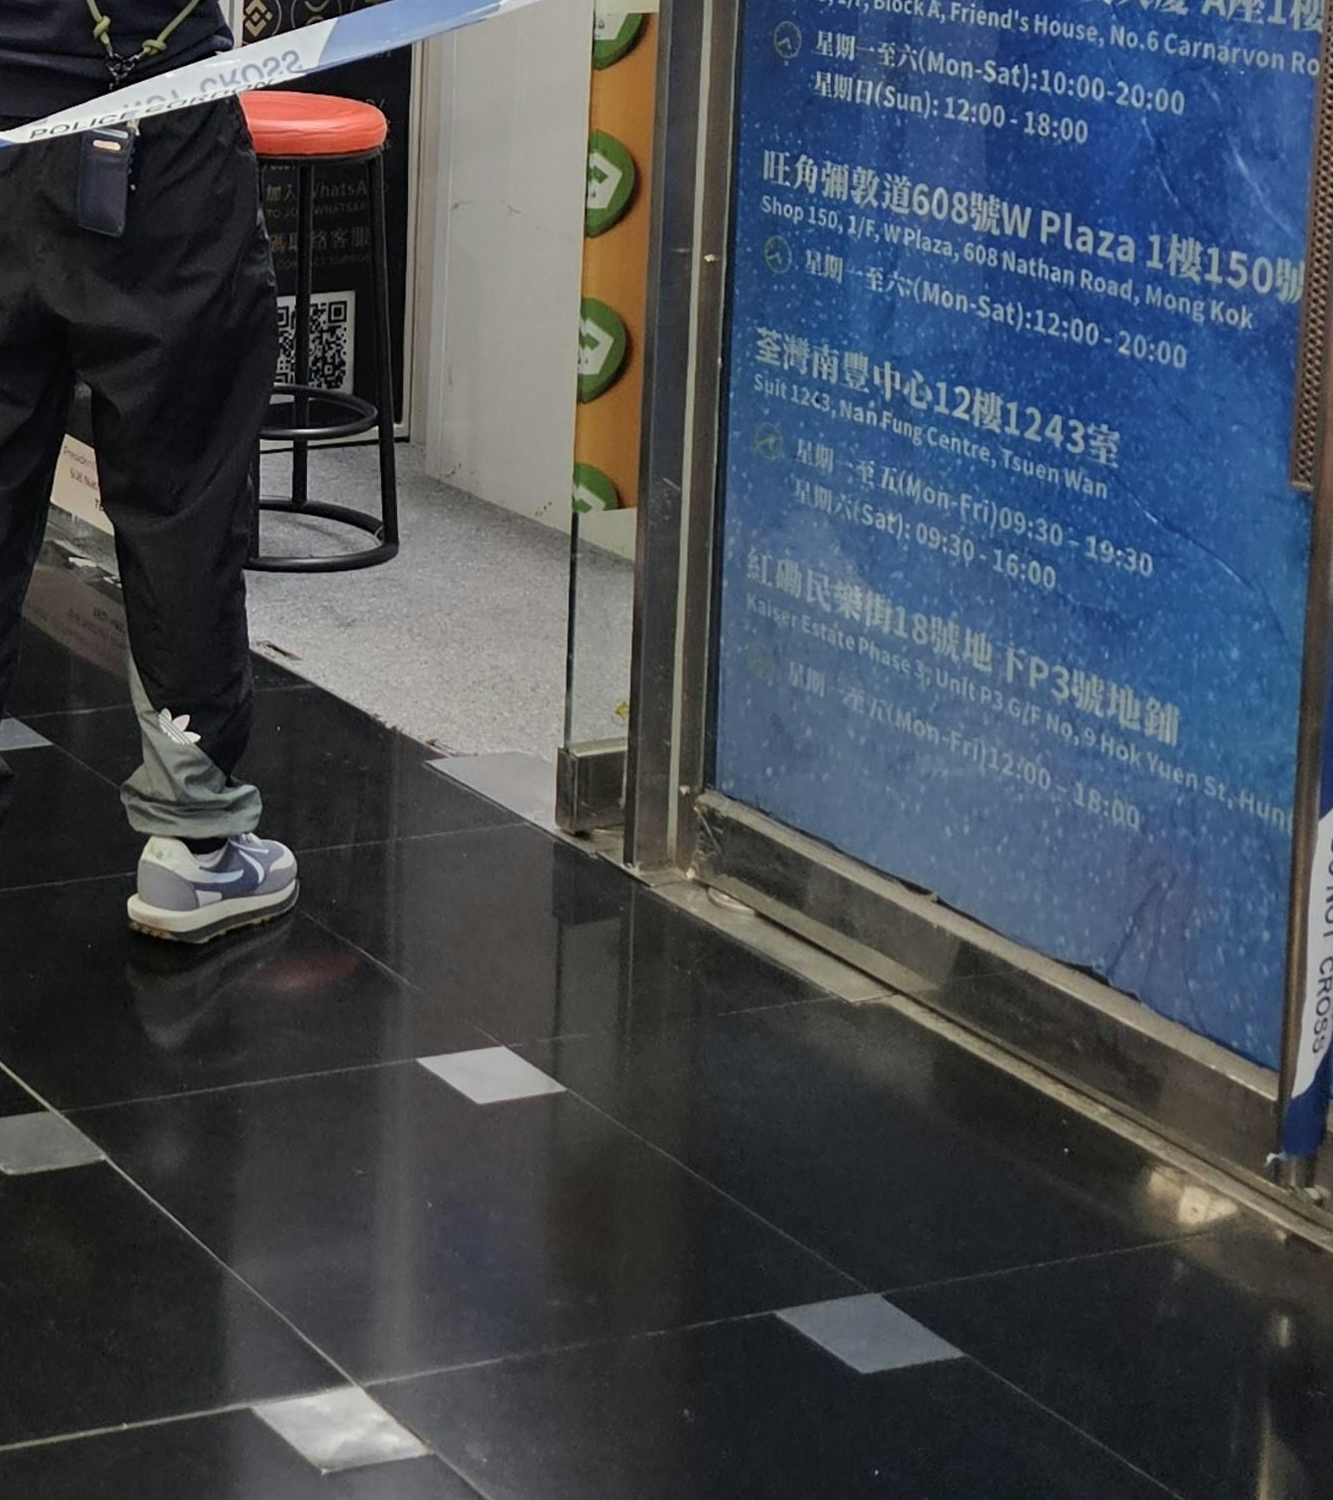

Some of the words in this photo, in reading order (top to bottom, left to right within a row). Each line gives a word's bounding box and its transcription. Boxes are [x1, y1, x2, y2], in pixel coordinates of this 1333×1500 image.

[949, 2, 1030, 32] Friend's
[1033, 14, 1105, 48] House,
[1109, 24, 1160, 52] No.6
[1163, 32, 1285, 71] Carnarvon
[943, 97, 1006, 129] 12:00
[1023, 109, 1089, 145] 18:00
[760, 194, 805, 225] Shop
[883, 221, 901, 246] W
[903, 226, 960, 264] Plaza,
[963, 241, 999, 268] 608
[1001, 251, 1075, 287] Nathan
[1079, 268, 1141, 307] Road,
[1144, 283, 1206, 323] Mong
[1209, 299, 1255, 330] Kok
[1039, 209, 1137, 264] Plaza
[1117, 329, 1189, 369] 20:00
[753, 372, 788, 400] Suit
[839, 399, 878, 428] Nan
[881, 410, 924, 447] Fung
[926, 425, 998, 469] Centre,
[999, 447, 1060, 486] Tsuen
[1062, 466, 1109, 500] Wan
[915, 521, 975, 563] 09:30
[992, 548, 1057, 591] 16:00
[1084, 534, 1154, 578] 19:30
[745, 592, 798, 630] Kaiser
[800, 613, 856, 651] Estate
[857, 635, 912, 676] Phase
[934, 666, 977, 703] Unit
[1100, 731, 1141, 767] Hok
[1145, 751, 1199, 792] Yuen
[1072, 781, 1142, 831] 18:00
